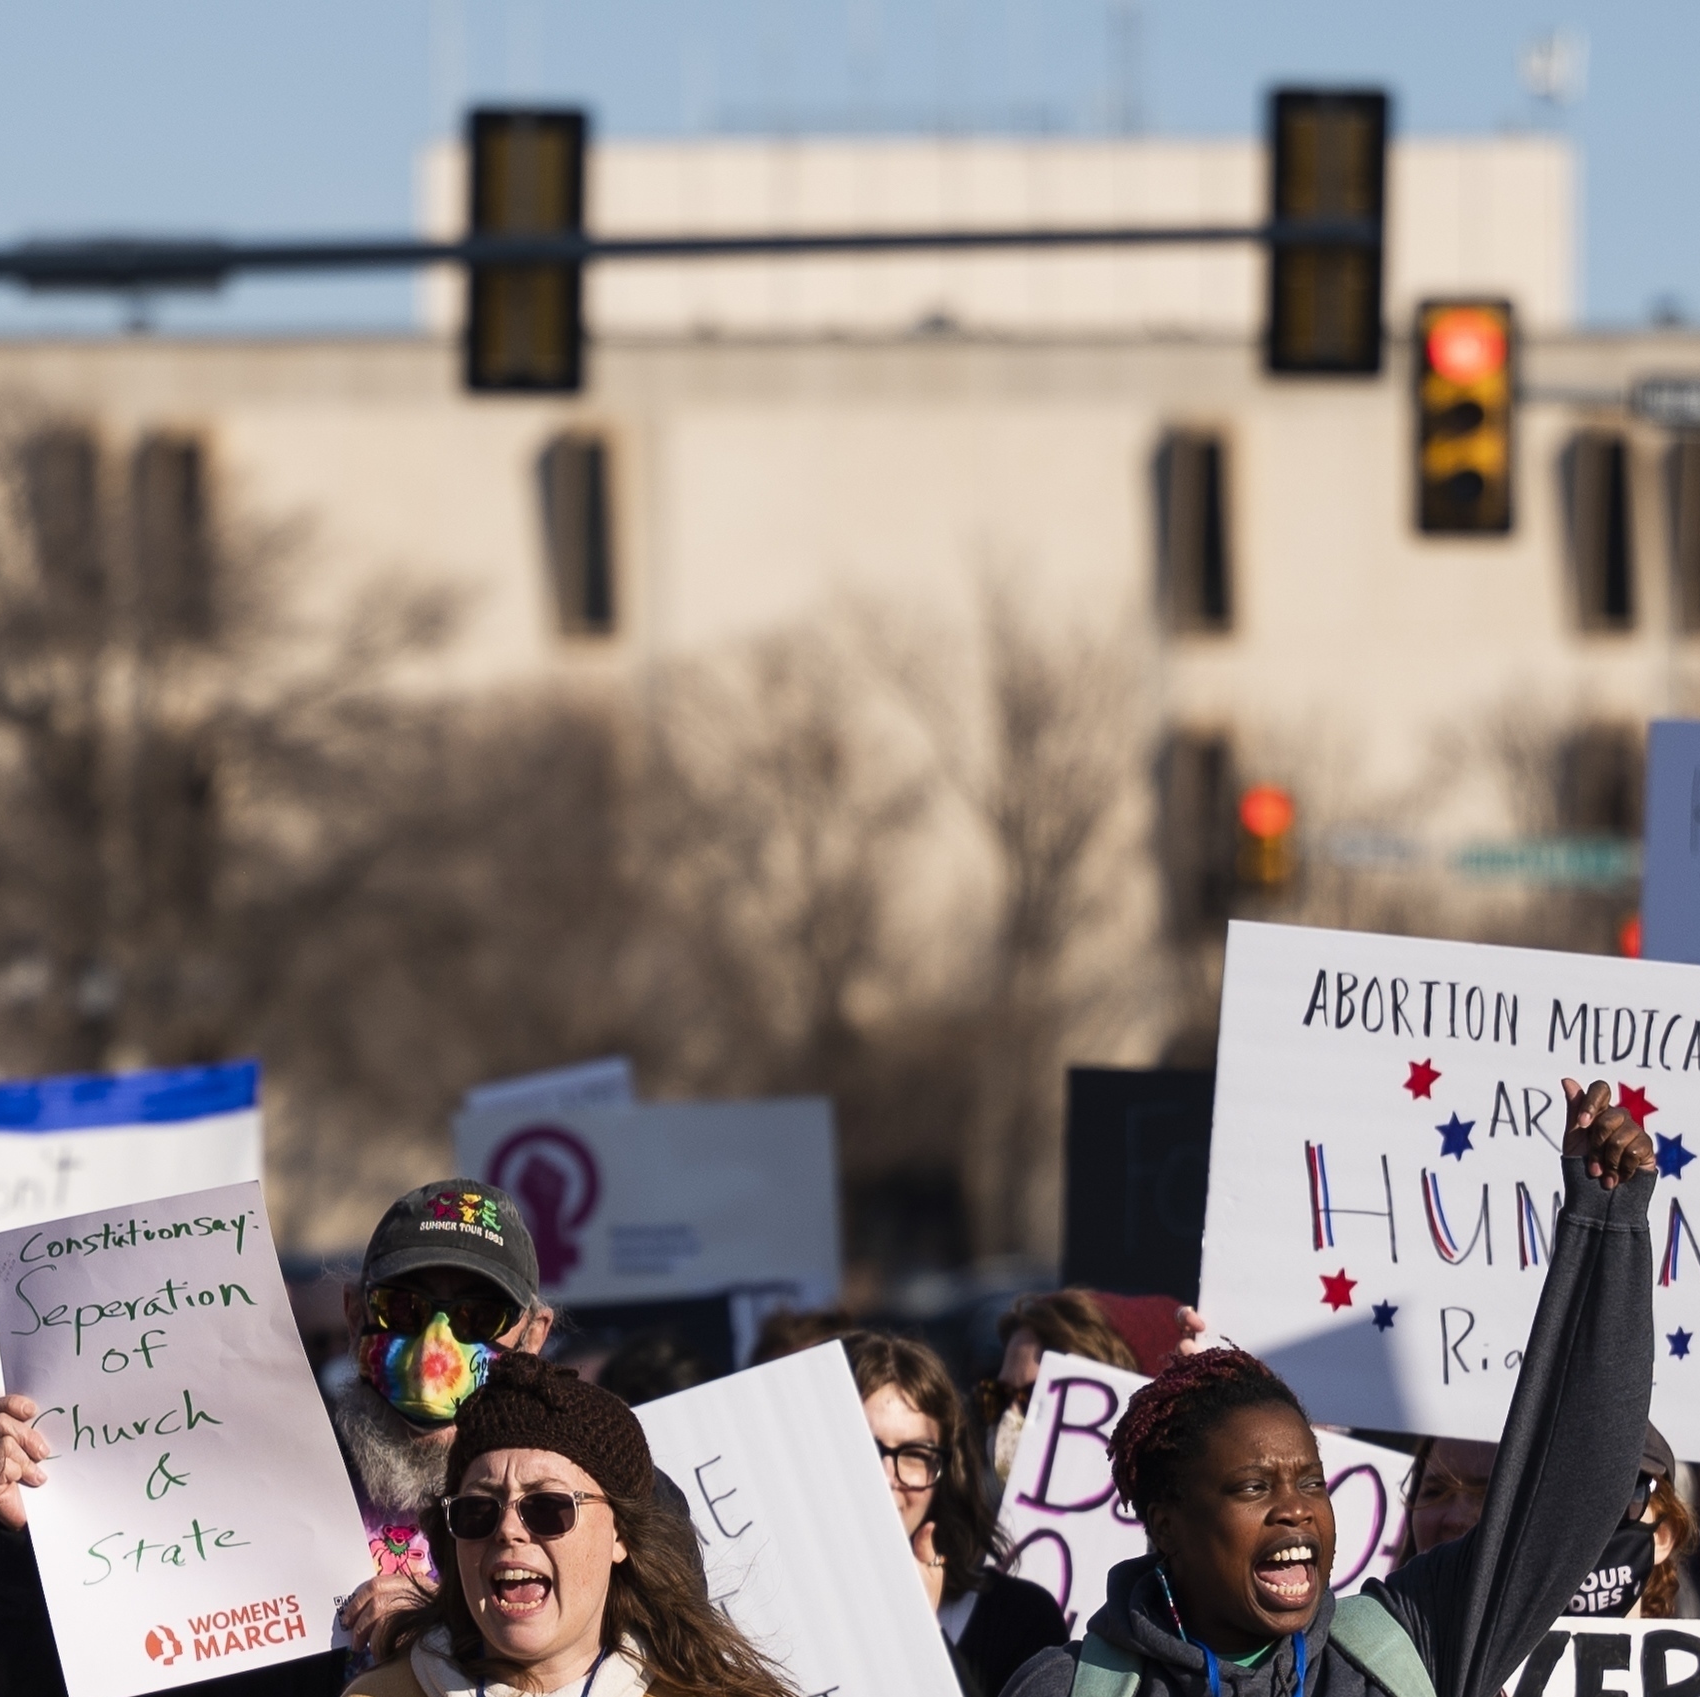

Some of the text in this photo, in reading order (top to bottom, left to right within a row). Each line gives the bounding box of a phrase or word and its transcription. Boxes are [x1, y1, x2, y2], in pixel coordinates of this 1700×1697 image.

[1302, 968, 1519, 1046] ABORTION
[1489, 1080, 1563, 1153] AR
[419, 1221, 457, 1232] SUMMER
[459, 1222, 483, 1237] TOUR
[11, 1264, 259, 1356] Seperation
[101, 1329, 168, 1373] of
[31, 1389, 224, 1460] Church
[146, 1452, 191, 1500] &
[83, 1519, 251, 1586] State
[188, 1594, 300, 1636] WOMEN'S
[192, 1615, 307, 1663] MARCH
